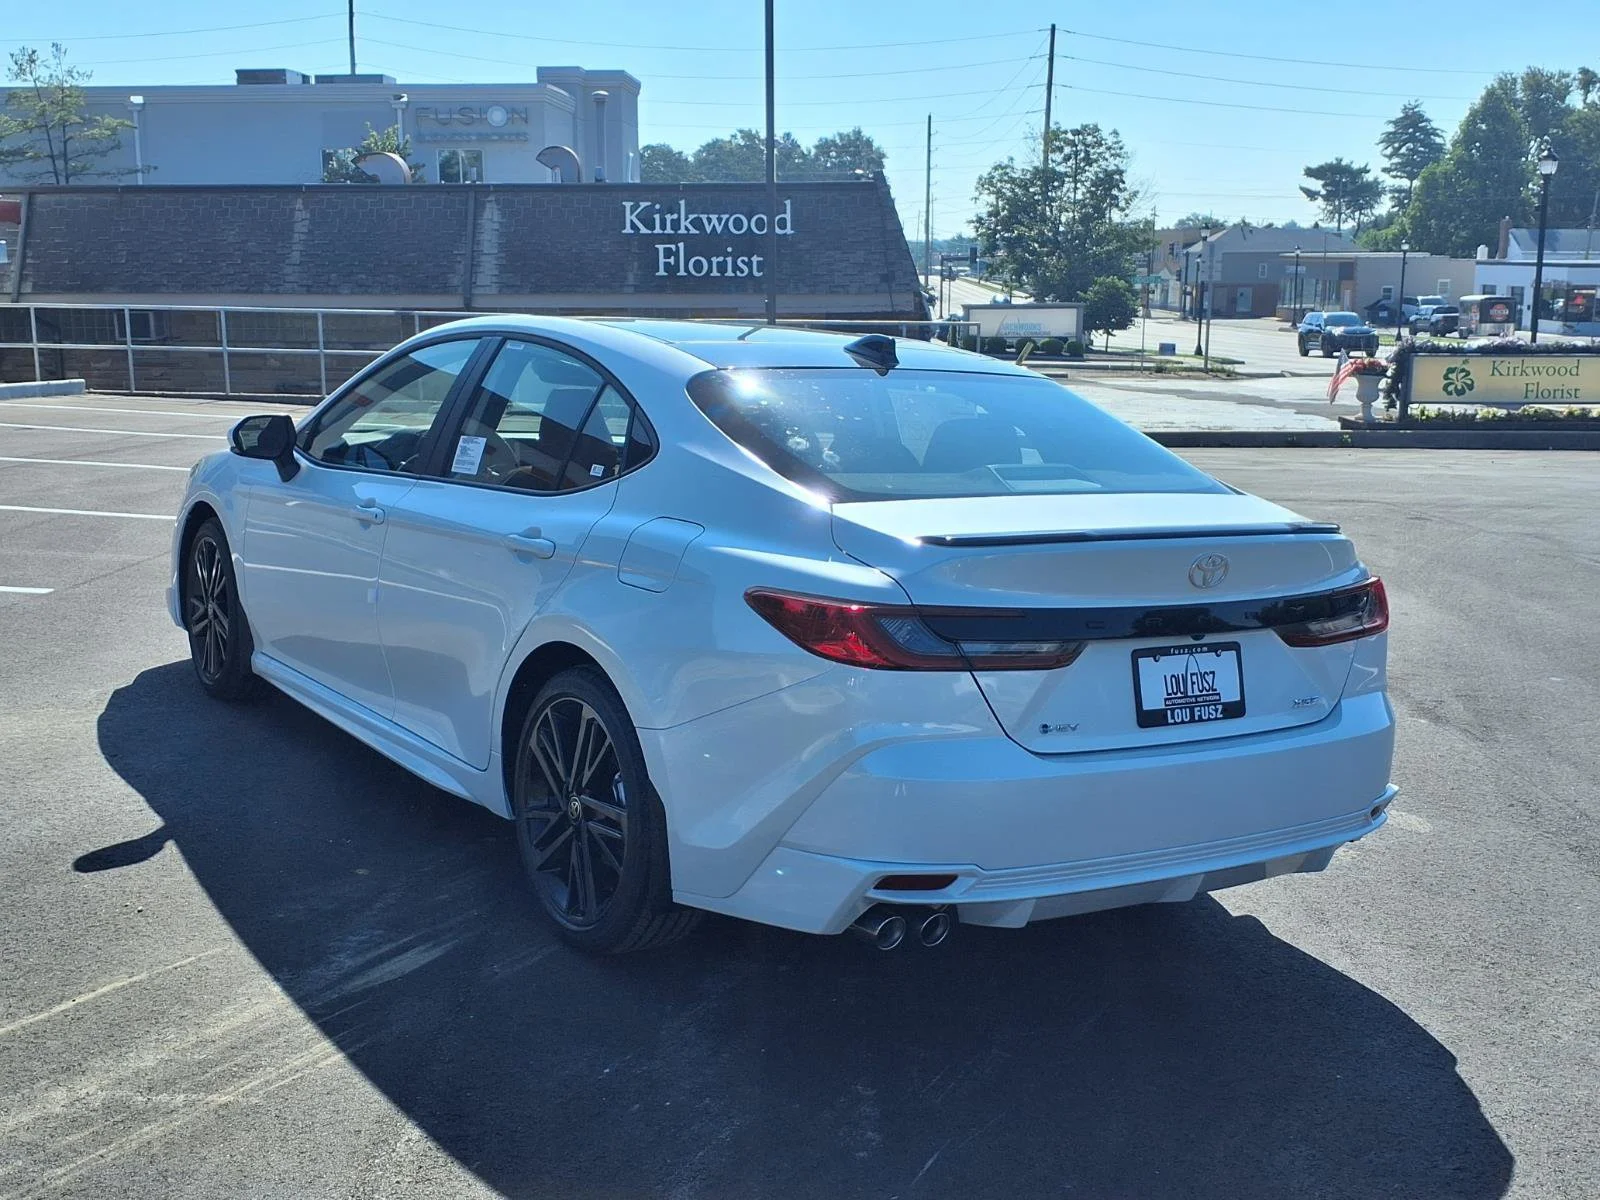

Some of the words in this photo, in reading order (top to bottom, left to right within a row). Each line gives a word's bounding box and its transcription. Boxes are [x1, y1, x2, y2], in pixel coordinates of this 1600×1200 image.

[415, 105, 529, 127] FUSION
[621, 199, 794, 234] Kirkwood
[654, 241, 764, 277] Florist
[1490, 359, 1580, 377] Kirkwood
[1524, 382, 1581, 400] Florist
[1170, 646, 1208, 655] fusz.com
[1163, 673, 1185, 696] LOU
[1190, 671, 1217, 694] FUSZ
[1167, 709, 1190, 723] LOU
[1194, 705, 1223, 720] FUSZ
